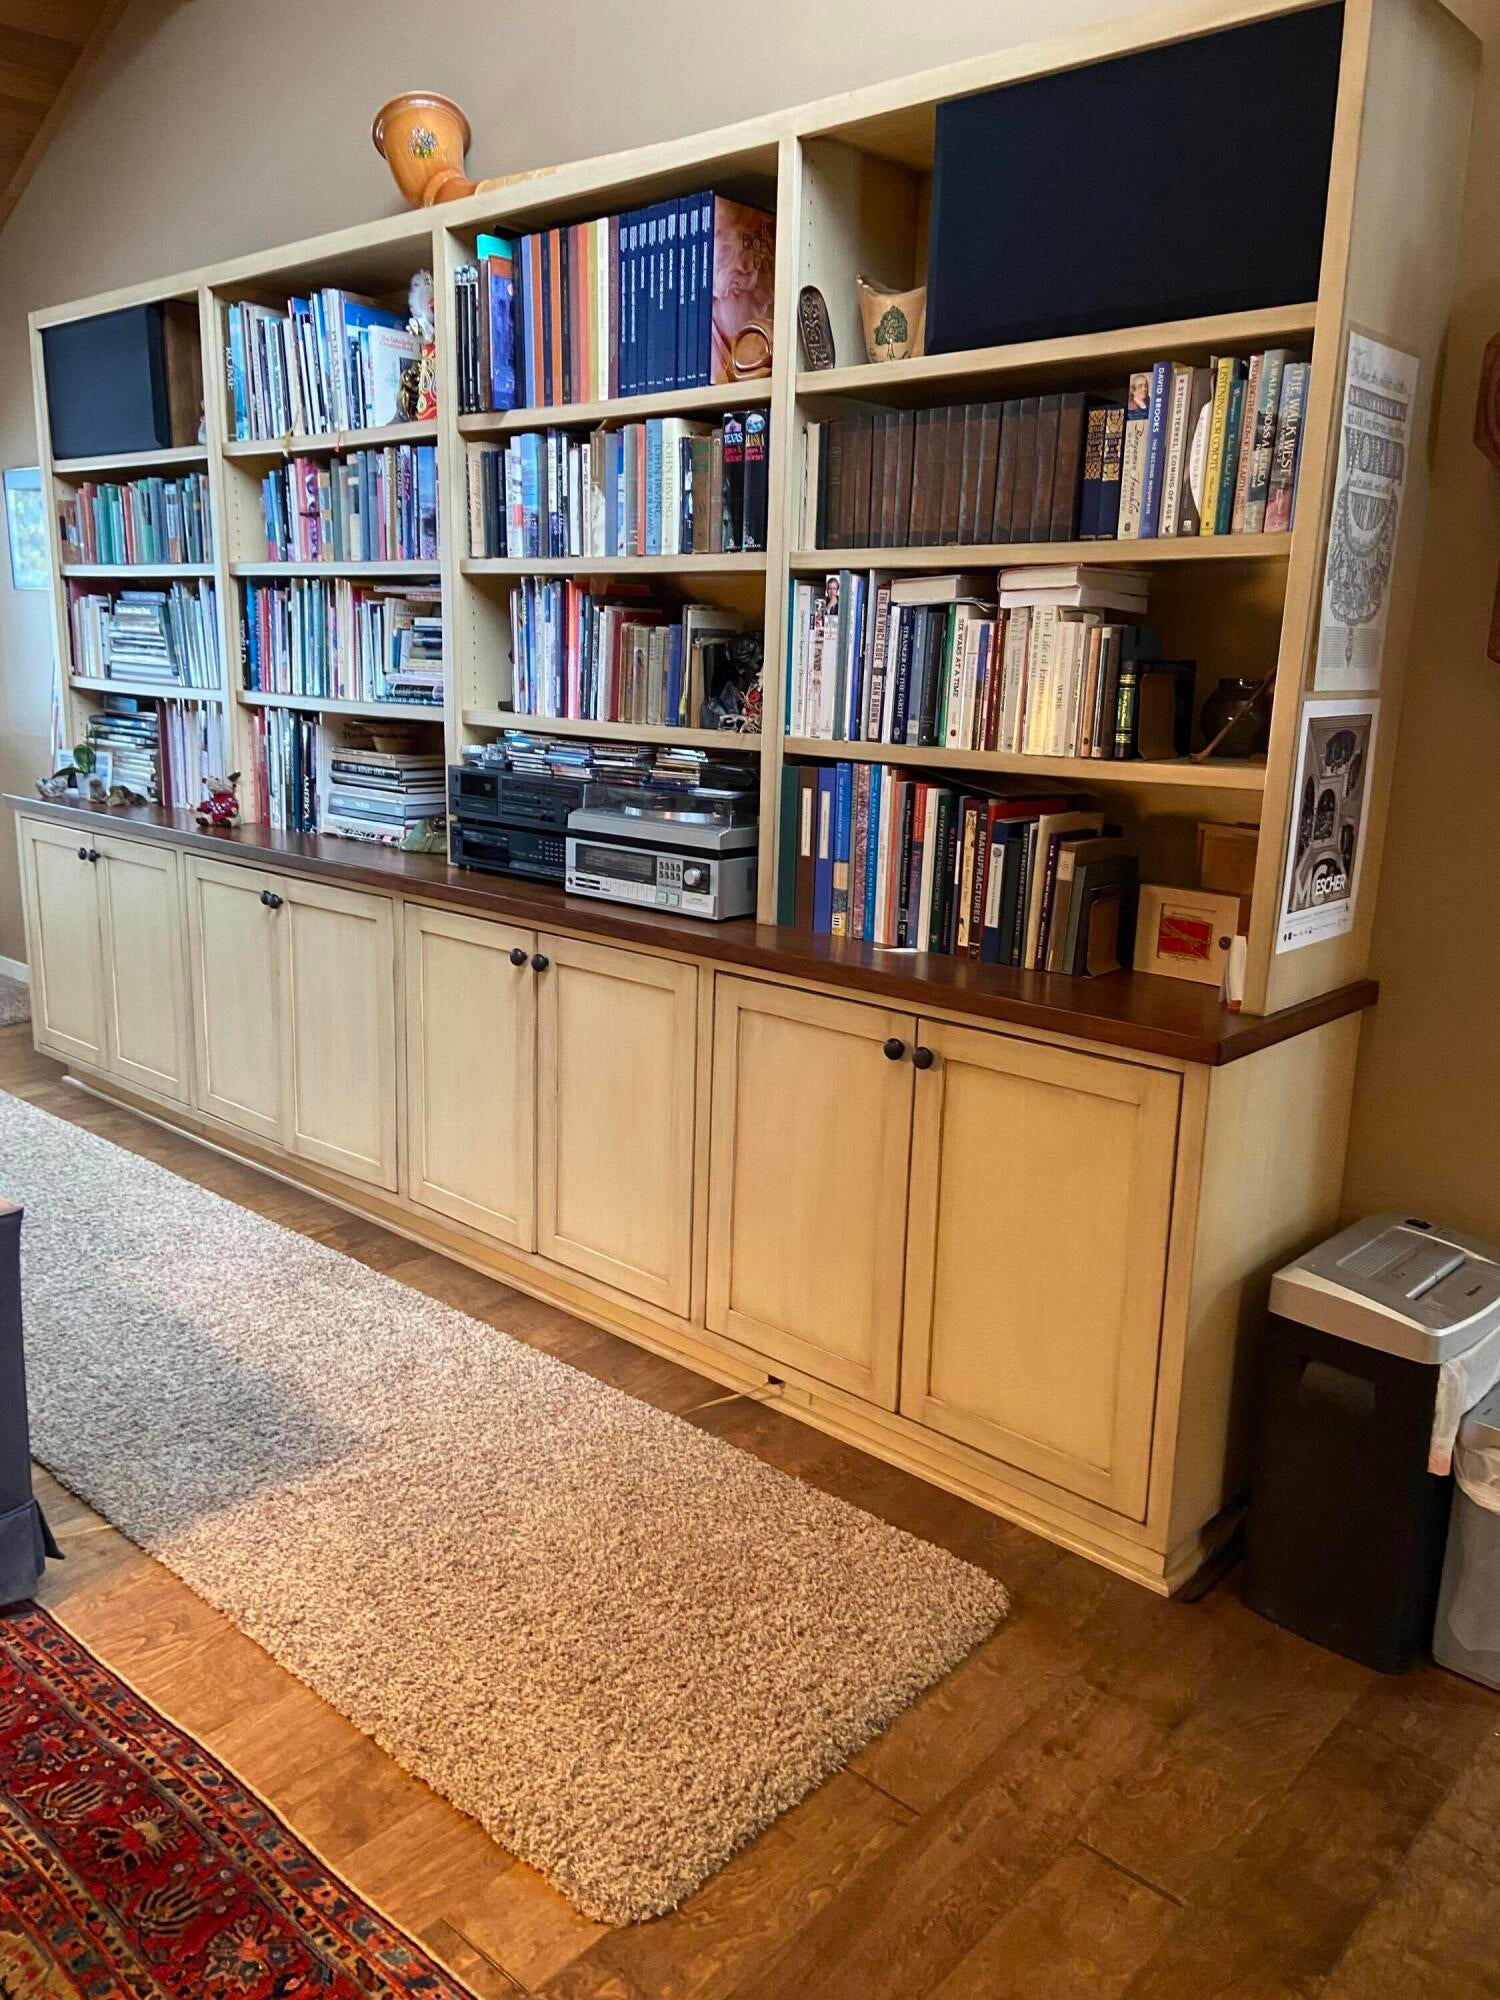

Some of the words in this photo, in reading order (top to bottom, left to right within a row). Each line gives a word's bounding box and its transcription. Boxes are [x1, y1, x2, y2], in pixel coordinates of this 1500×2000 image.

[1156, 367, 1165, 394] DAVID
[1215, 366, 1228, 415] LISTENING
[1267, 368, 1280, 397] WALK
[1290, 368, 1304, 396] THE
[1176, 386, 1184, 415] STUDS
[1152, 398, 1162, 433] BROOKS
[1214, 417, 1224, 435] FOR
[1262, 398, 1275, 438] ACROSS
[1285, 398, 1300, 436] WALK
[1132, 423, 1145, 470] Benjamin
[1172, 417, 1181, 448] TERKEL
[654, 444, 662, 474] JOHN
[665, 440, 674, 474] JOHN
[1149, 452, 1157, 479] SECOND
[1209, 437, 1221, 473] COYOTE
[1280, 438, 1296, 476] WEST
[1168, 455, 1177, 488] COMING
[654, 477, 662, 519] IRVING
[664, 477, 674, 519] IRVING
[1128, 475, 1140, 514] Franklin
[1145, 480, 1153, 514] MOUNTAIN
[1168, 490, 1174, 502] OF
[878, 592, 888, 606] THE
[878, 608, 887, 618] DA
[876, 620, 886, 642] VINCI
[1032, 611, 1042, 644] RICHARD
[1043, 611, 1054, 630] The
[874, 643, 884, 662] CODE
[901, 626, 910, 663] STRANGER
[955, 634, 964, 656] WARS
[1042, 633, 1052, 653] Life
[900, 664, 906, 676] ON
[954, 657, 962, 668] AT
[1040, 654, 1050, 664] of
[873, 682, 882, 694] DAN
[898, 677, 906, 692] THE
[952, 678, 960, 699] TIME
[1056, 684, 1064, 712] WORK
[870, 698, 880, 724] BROWN
[946, 828, 956, 872] WALKING
[972, 831, 987, 924] MANUFRACTURED
[1315, 873, 1346, 896] ESCHER
